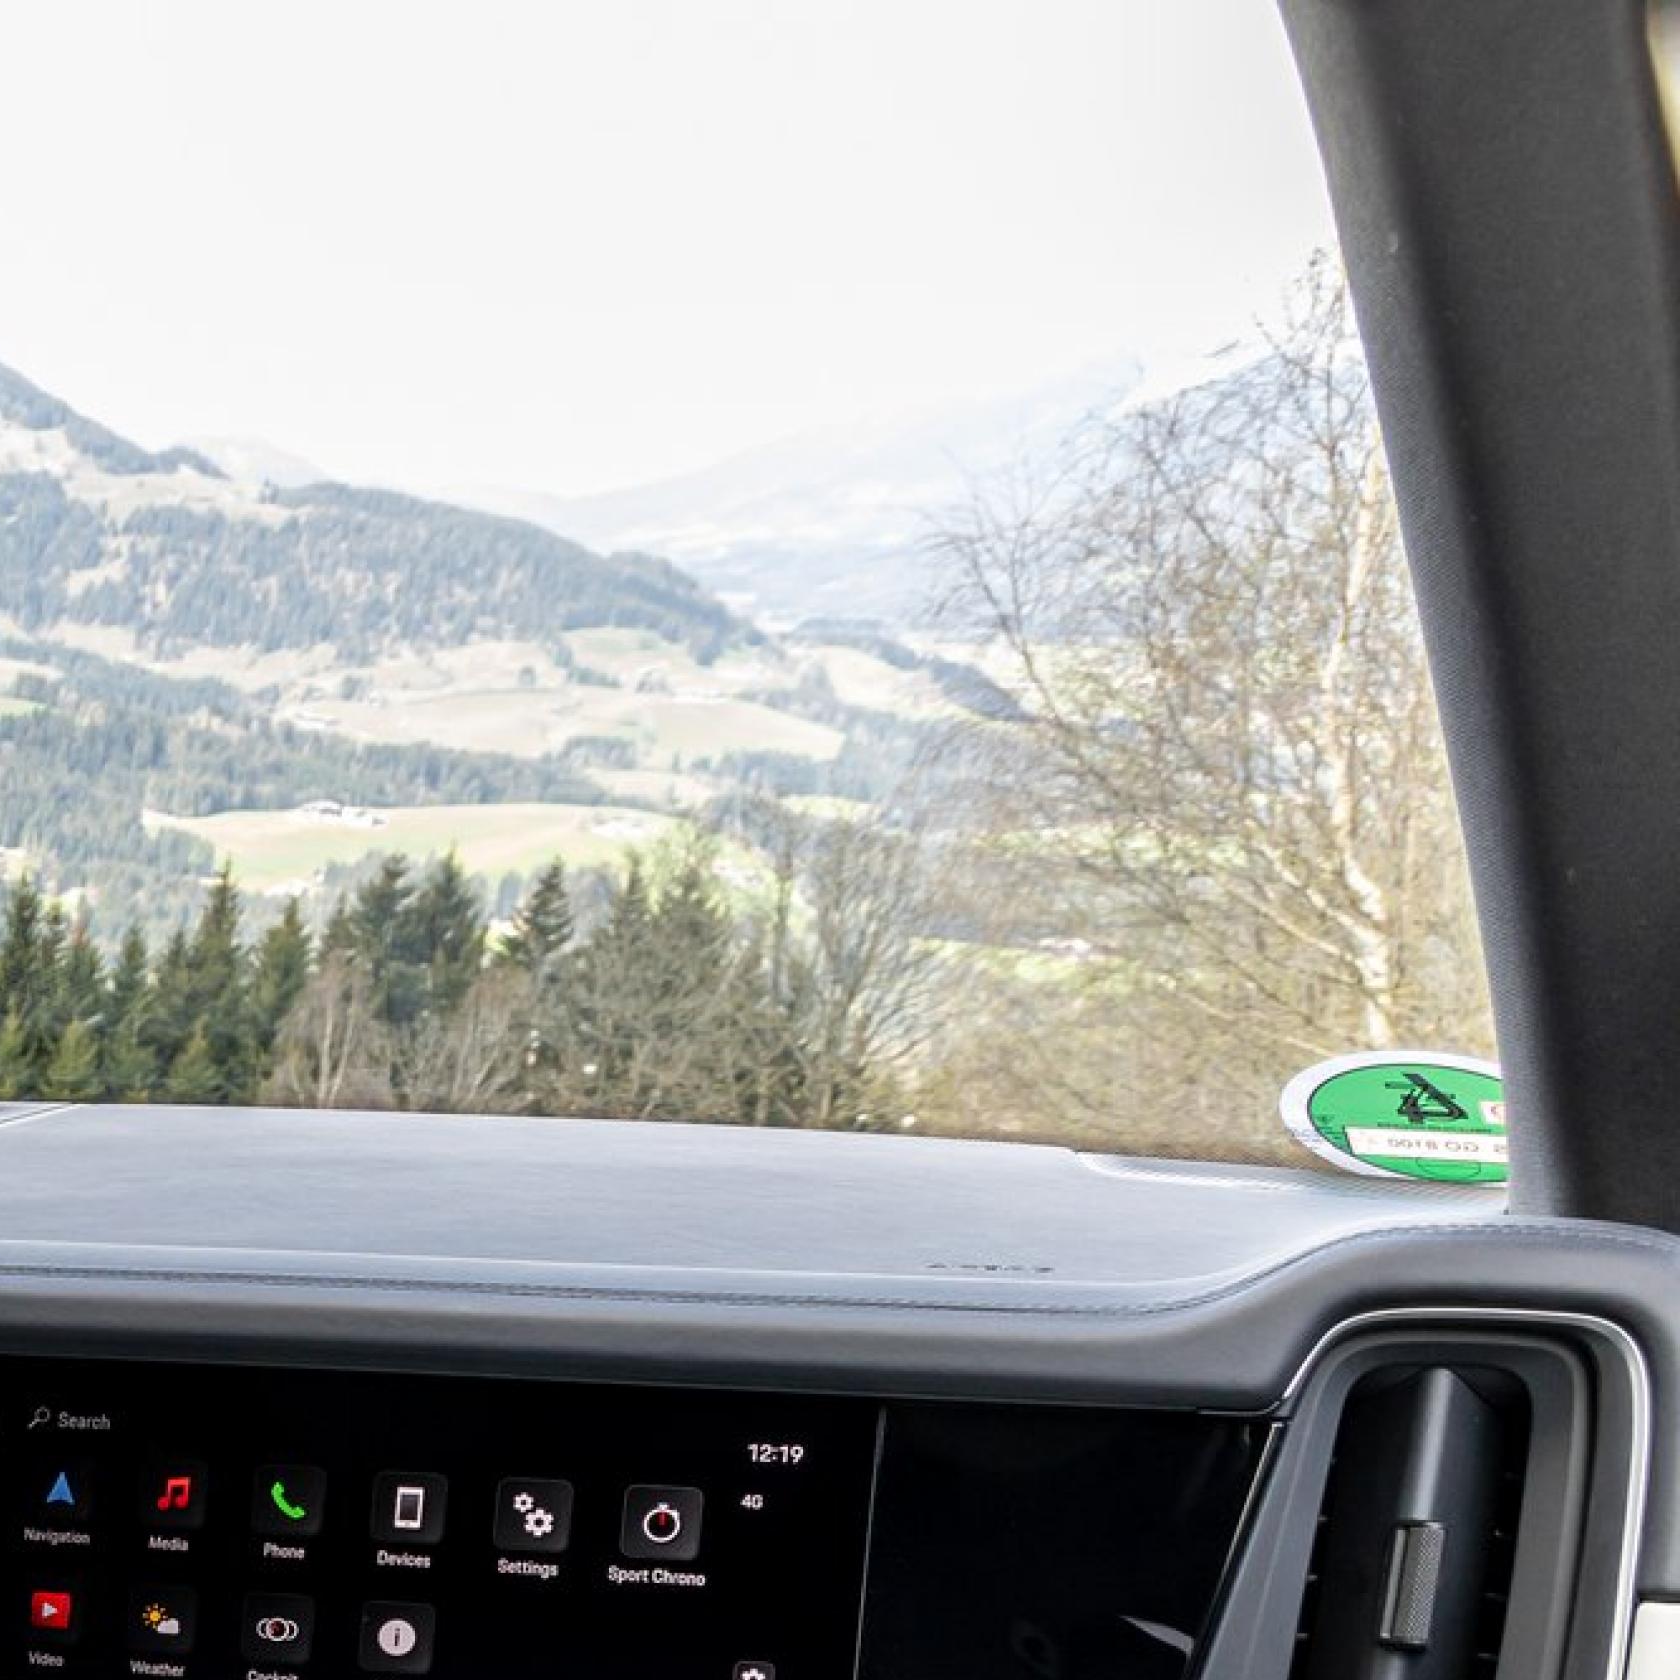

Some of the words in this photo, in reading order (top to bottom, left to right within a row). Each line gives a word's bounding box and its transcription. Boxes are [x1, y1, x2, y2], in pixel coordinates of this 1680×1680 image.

[57, 1411, 111, 1430] Search
[746, 1443, 805, 1464] 12:19
[23, 1526, 91, 1546] Navigation
[147, 1534, 190, 1551] Media
[263, 1541, 306, 1560] Phone
[375, 1549, 432, 1569] Devices
[496, 1557, 560, 1580] Settings
[607, 1564, 650, 1586] Sport
[650, 1568, 707, 1588] Chrono
[27, 1650, 66, 1668] Video
[129, 1658, 186, 1678] Weather
